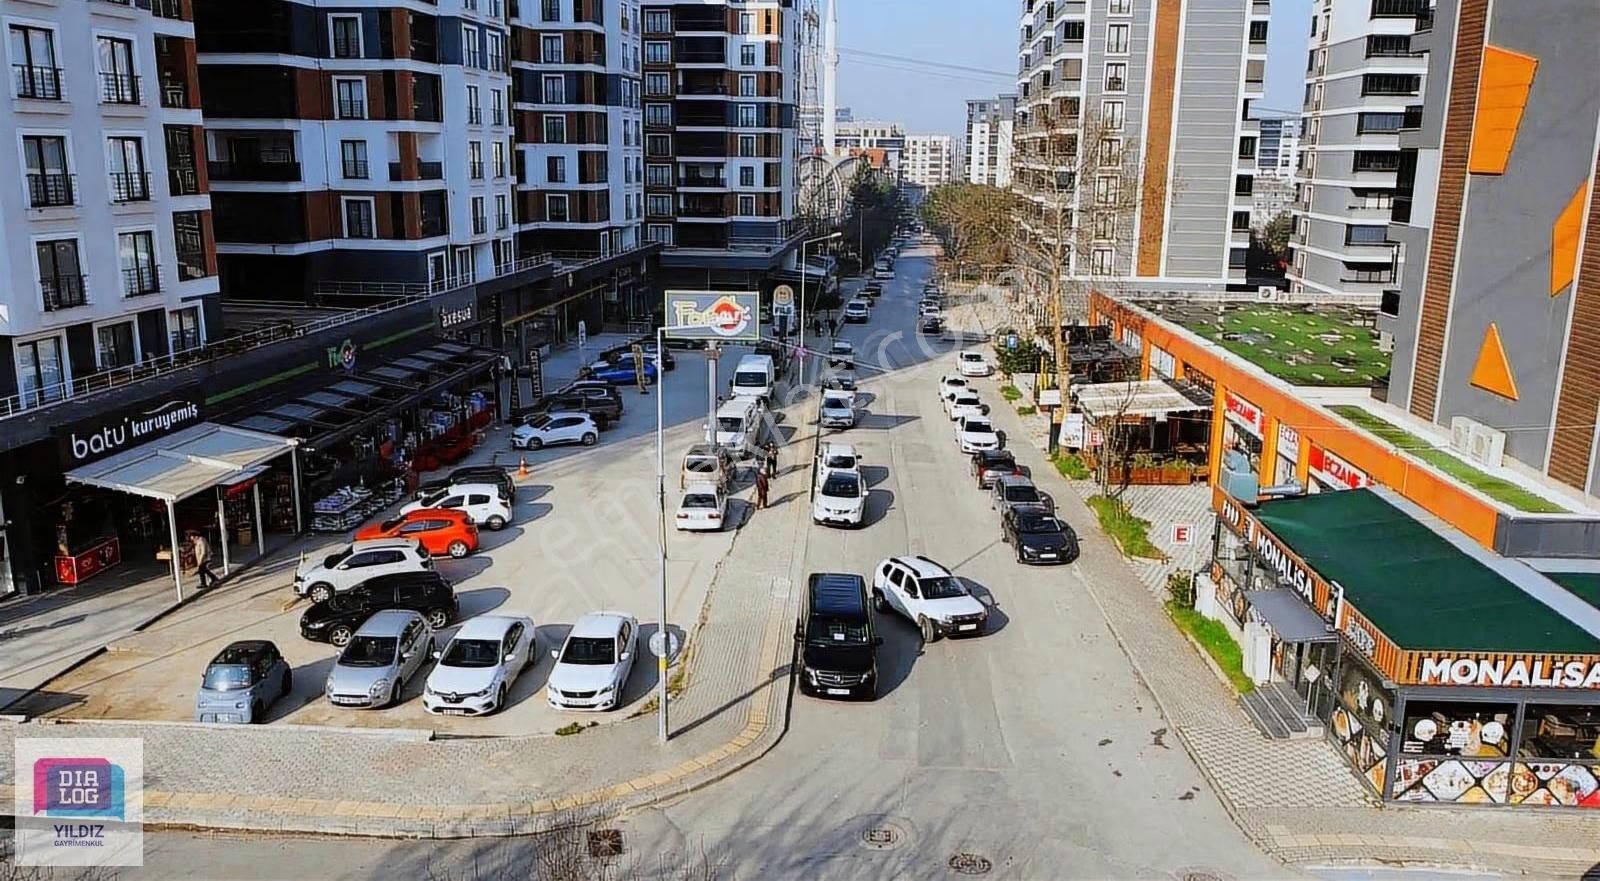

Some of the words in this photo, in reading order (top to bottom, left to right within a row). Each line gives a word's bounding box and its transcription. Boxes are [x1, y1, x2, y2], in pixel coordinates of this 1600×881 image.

[71, 425, 125, 459] batu
[131, 401, 198, 438] kuruyemiş
[1176, 528, 1188, 543] E
